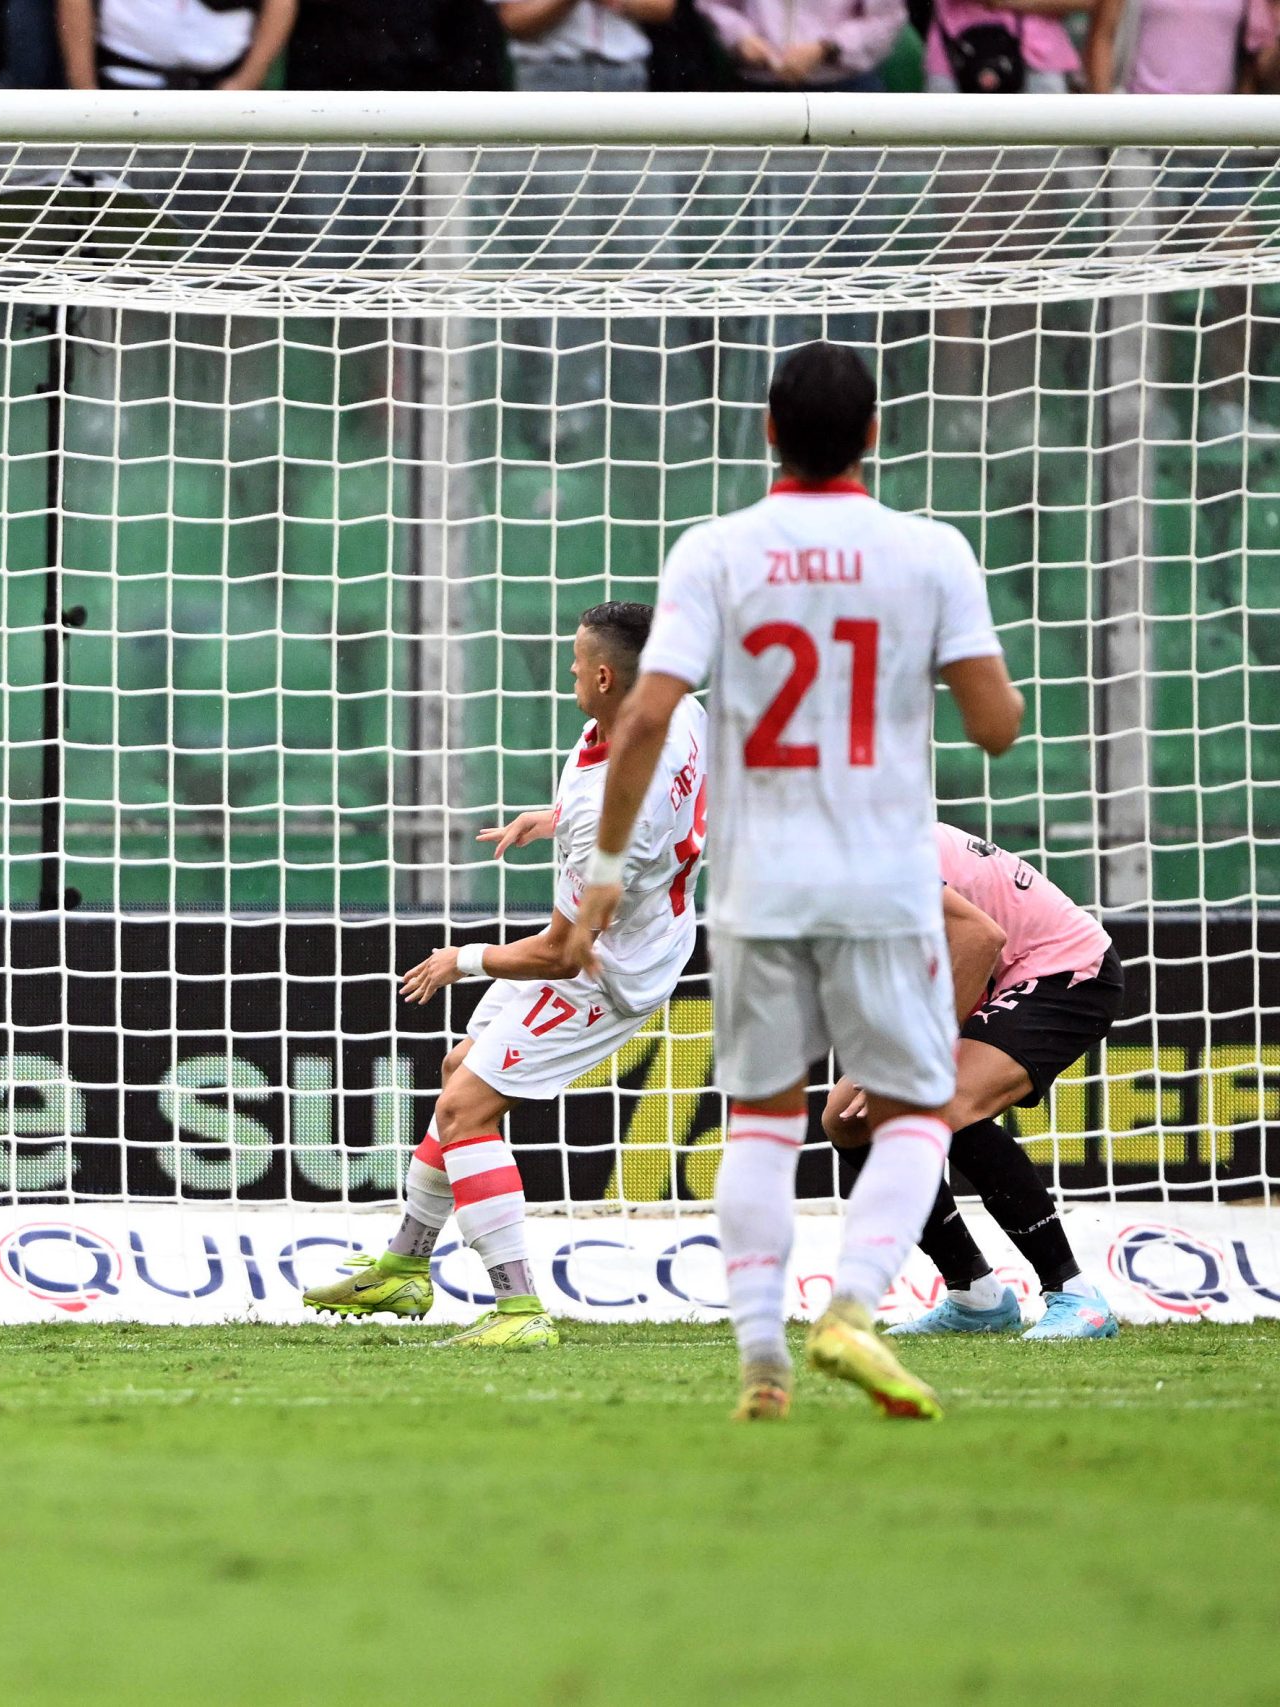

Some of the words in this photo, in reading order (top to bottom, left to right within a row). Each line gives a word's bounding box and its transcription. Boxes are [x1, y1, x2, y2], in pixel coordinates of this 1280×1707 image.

[765, 549, 863, 586] ZUELLI
[742, 617, 880, 769] 21
[522, 986, 578, 1037] 17
[157, 1053, 415, 1191] su
[6, 1228, 724, 1308] QUIGOCO
